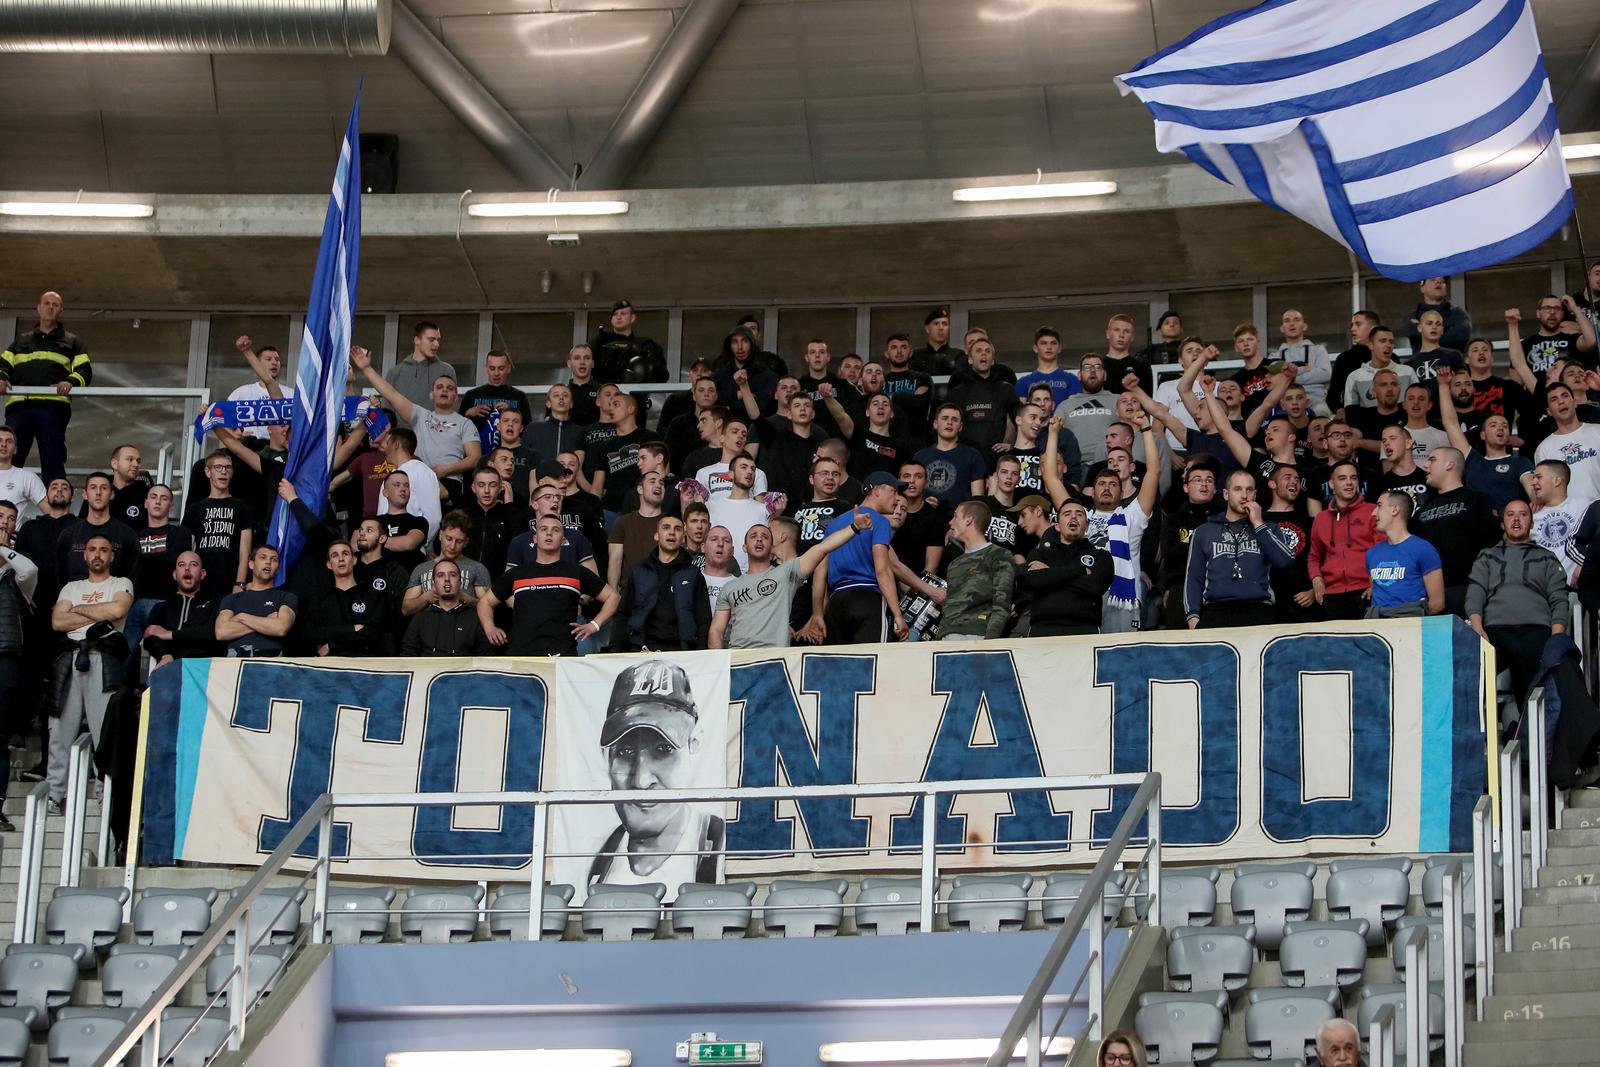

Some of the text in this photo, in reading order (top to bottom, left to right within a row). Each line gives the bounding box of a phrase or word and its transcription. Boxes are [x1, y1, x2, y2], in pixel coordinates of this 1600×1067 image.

[1069, 407, 1112, 418] adidas
[205, 507, 234, 520] ZAPALIM
[212, 521, 235, 535] JEDNU
[1212, 539, 1260, 558] LONSALE
